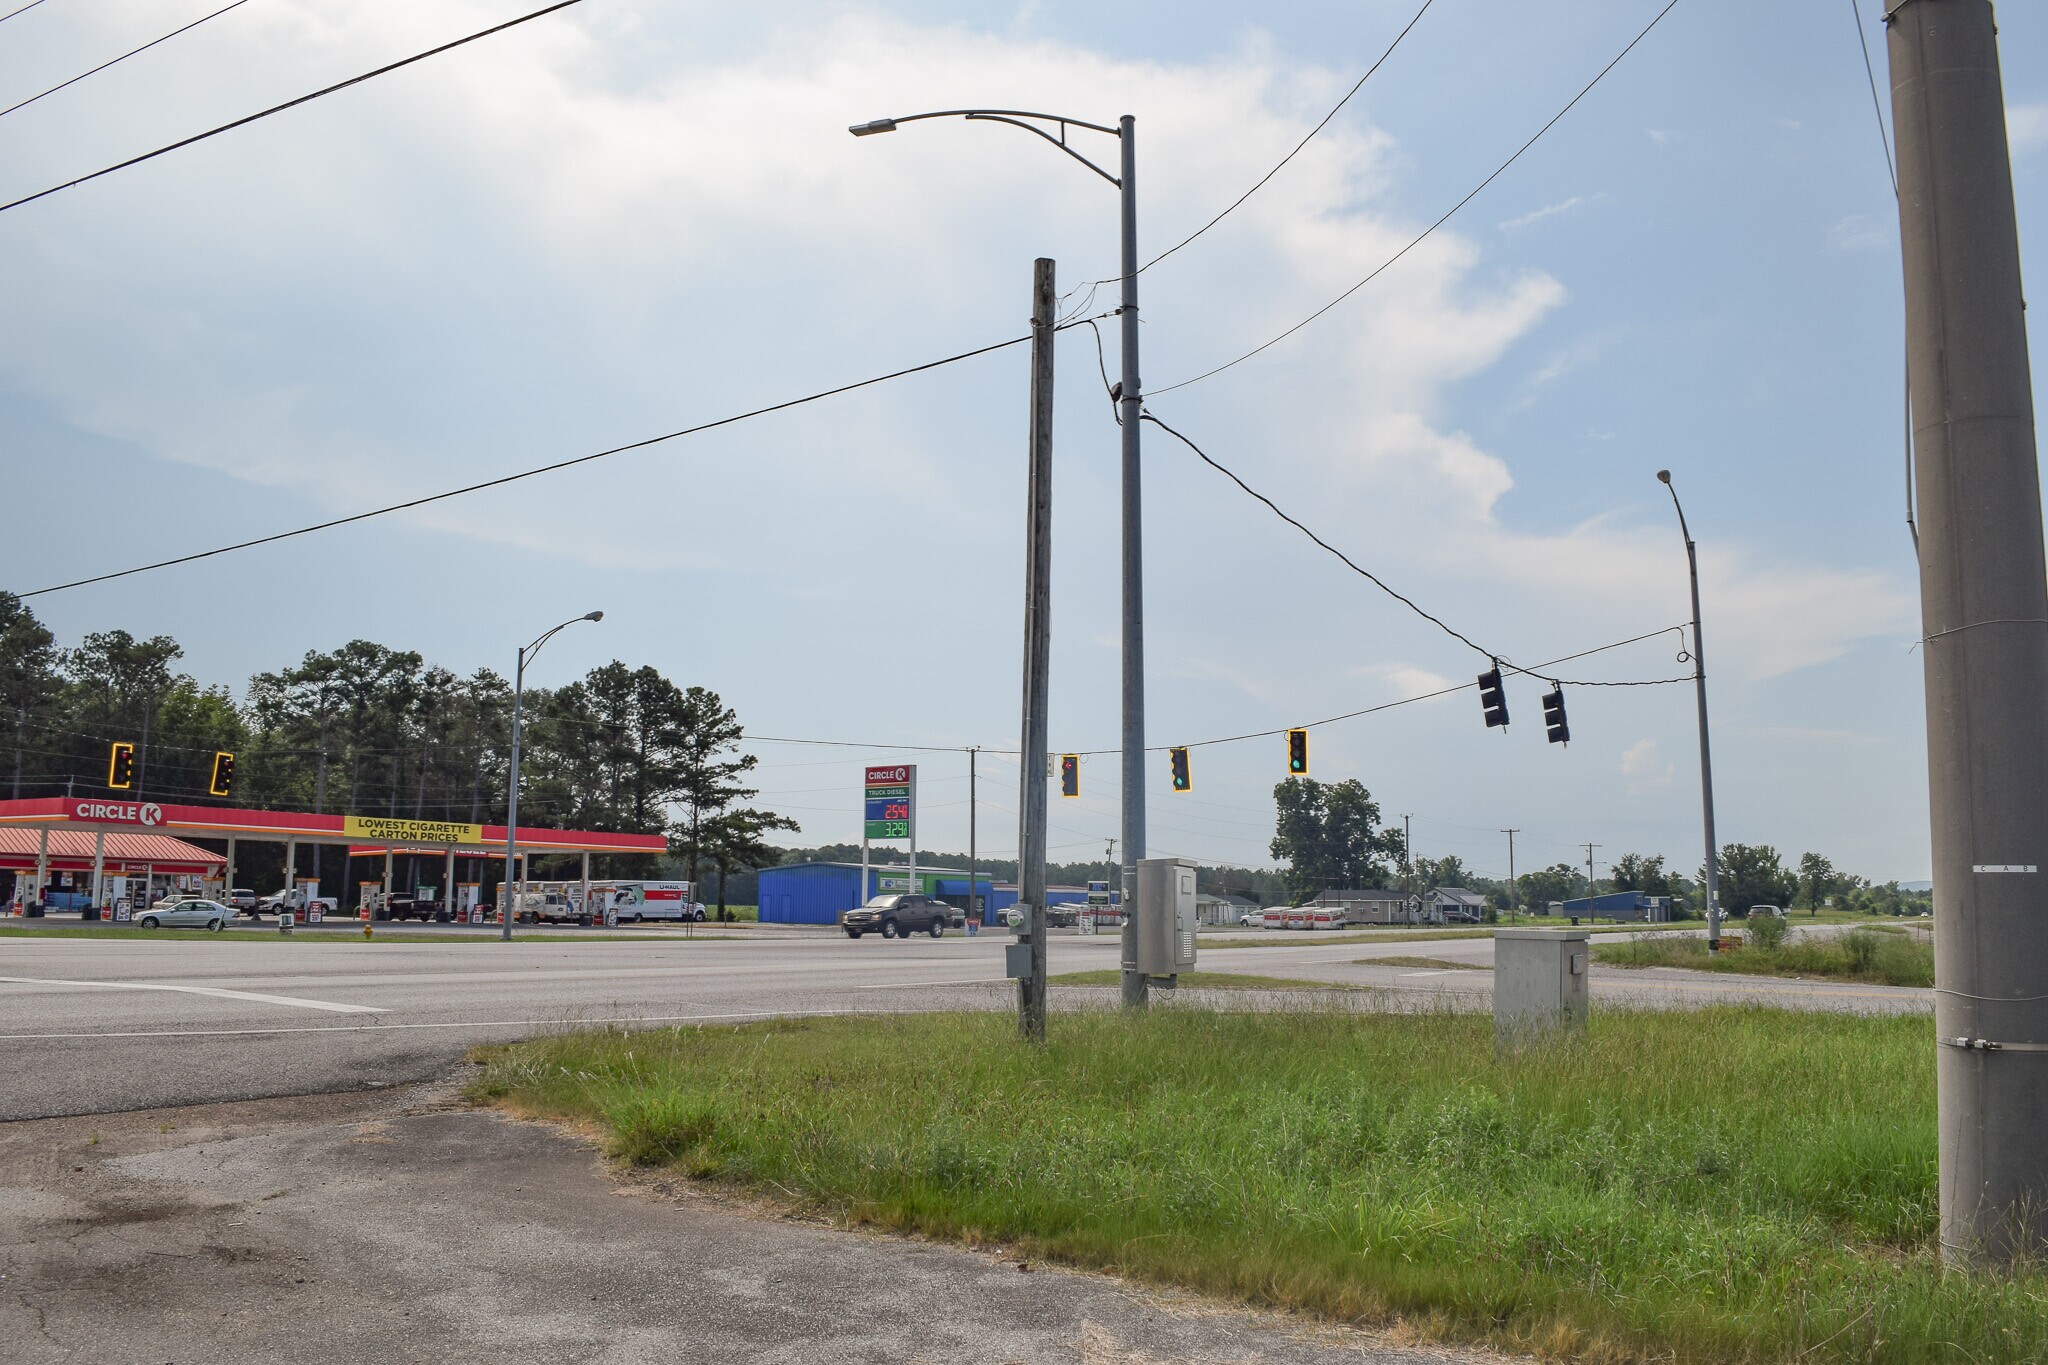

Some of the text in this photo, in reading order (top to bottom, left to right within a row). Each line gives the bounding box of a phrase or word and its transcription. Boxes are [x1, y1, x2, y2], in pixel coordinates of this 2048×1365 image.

[868, 768, 906, 780] CIRCLE K
[76, 804, 162, 826] CIRCLE K
[358, 819, 470, 834] LOWEST CIGARETTE
[370, 830, 458, 842] CARTON PRICES
